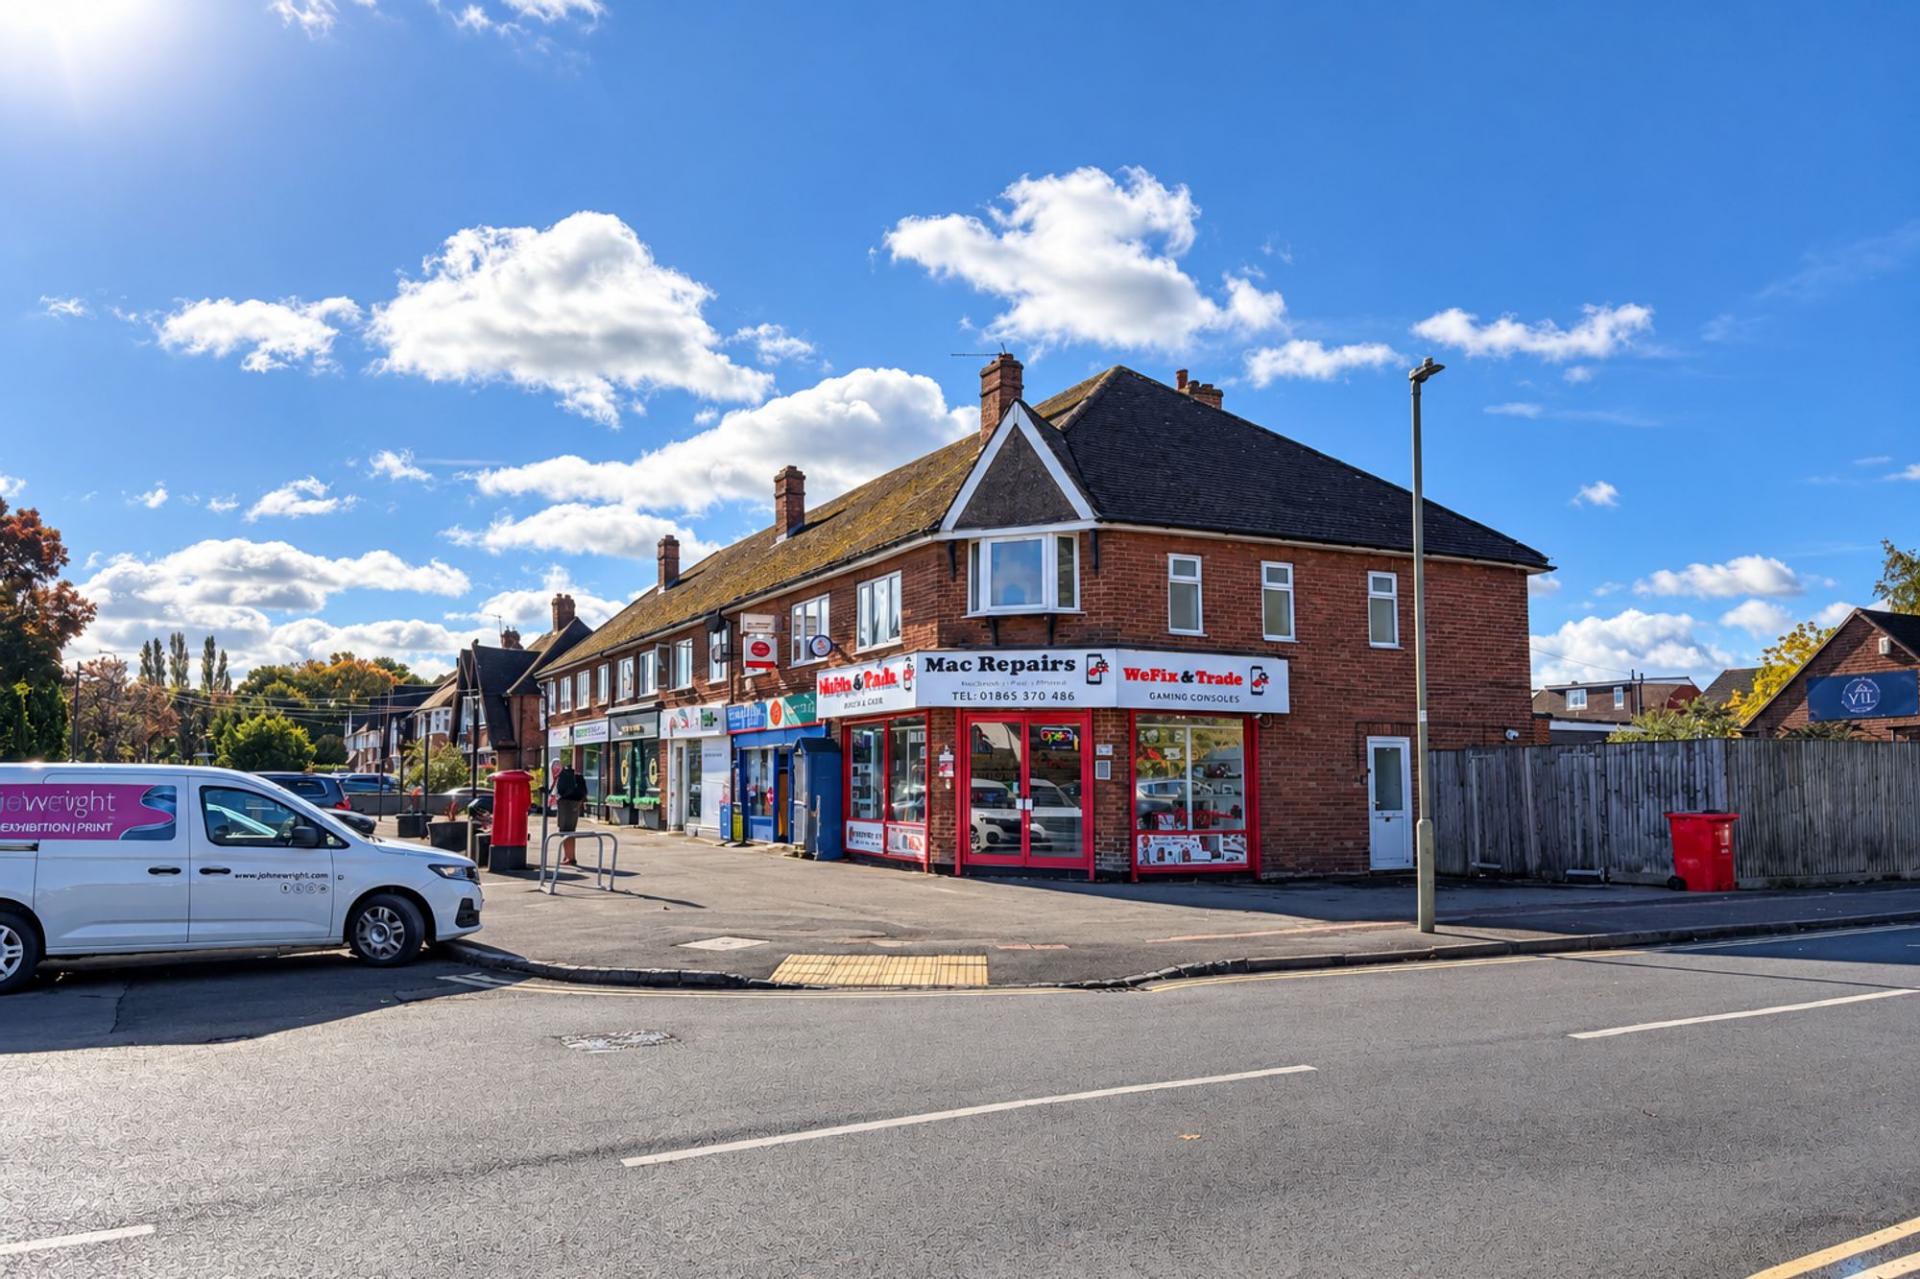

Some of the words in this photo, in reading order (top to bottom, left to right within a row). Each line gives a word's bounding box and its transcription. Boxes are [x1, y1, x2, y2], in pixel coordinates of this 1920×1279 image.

[925, 656, 973, 673] Mac
[977, 654, 1076, 676] Repairs
[1123, 667, 1179, 684] WeFix
[1180, 670, 1194, 684] &
[1195, 670, 1243, 686] Trade
[952, 691, 977, 702] TEL:
[980, 691, 1018, 702] 01865
[1023, 691, 1046, 702] 370
[1051, 691, 1075, 702] 486
[1149, 691, 1188, 702] GAMING
[1190, 693, 1241, 704] CONSOLES
